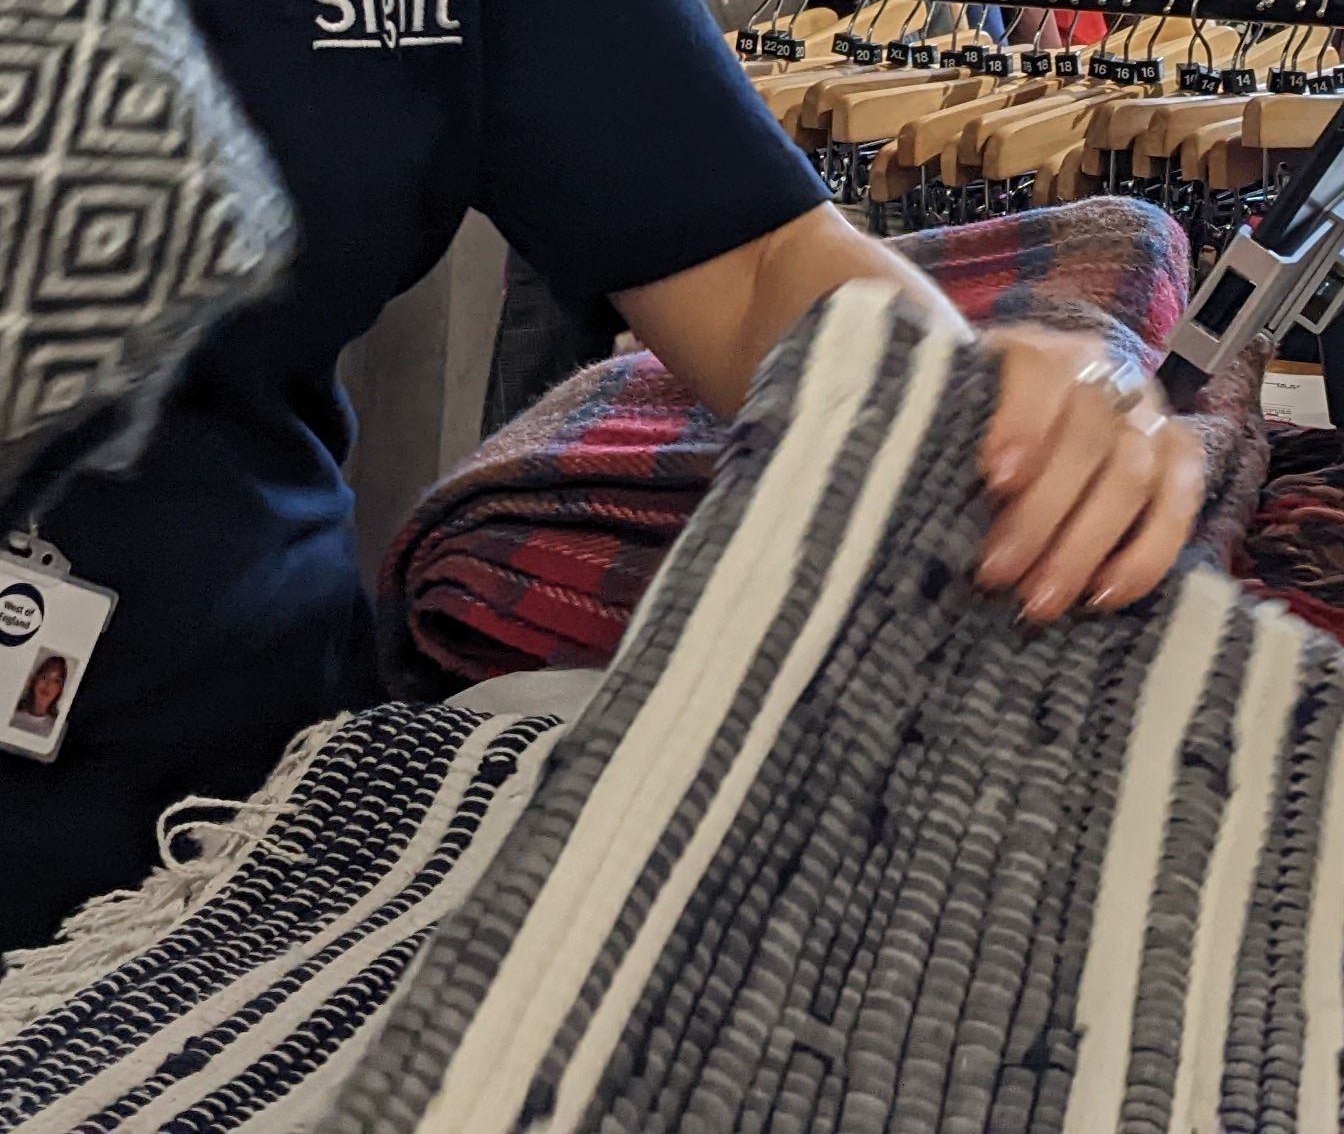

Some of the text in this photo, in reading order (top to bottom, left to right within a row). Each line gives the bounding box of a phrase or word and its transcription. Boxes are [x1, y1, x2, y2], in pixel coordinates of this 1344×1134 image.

[740, 38, 753, 50] 18
[764, 40, 777, 52] 22
[776, 44, 790, 56] 20
[835, 40, 849, 53] 20
[856, 49, 870, 61] 20
[890, 48, 906, 60] XL
[914, 51, 929, 63] 18
[964, 51, 978, 63] 18
[989, 60, 1002, 72] 18
[1036, 59, 1049, 72] 18
[1058, 60, 1072, 73] 18
[1093, 63, 1107, 75] 16
[1116, 67, 1130, 80] 16
[1141, 66, 1155, 78] 16
[1202, 79, 1215, 92] 14
[1236, 73, 1251, 87] 14
[1289, 75, 1304, 87] 14
[1313, 81, 1328, 94] 14
